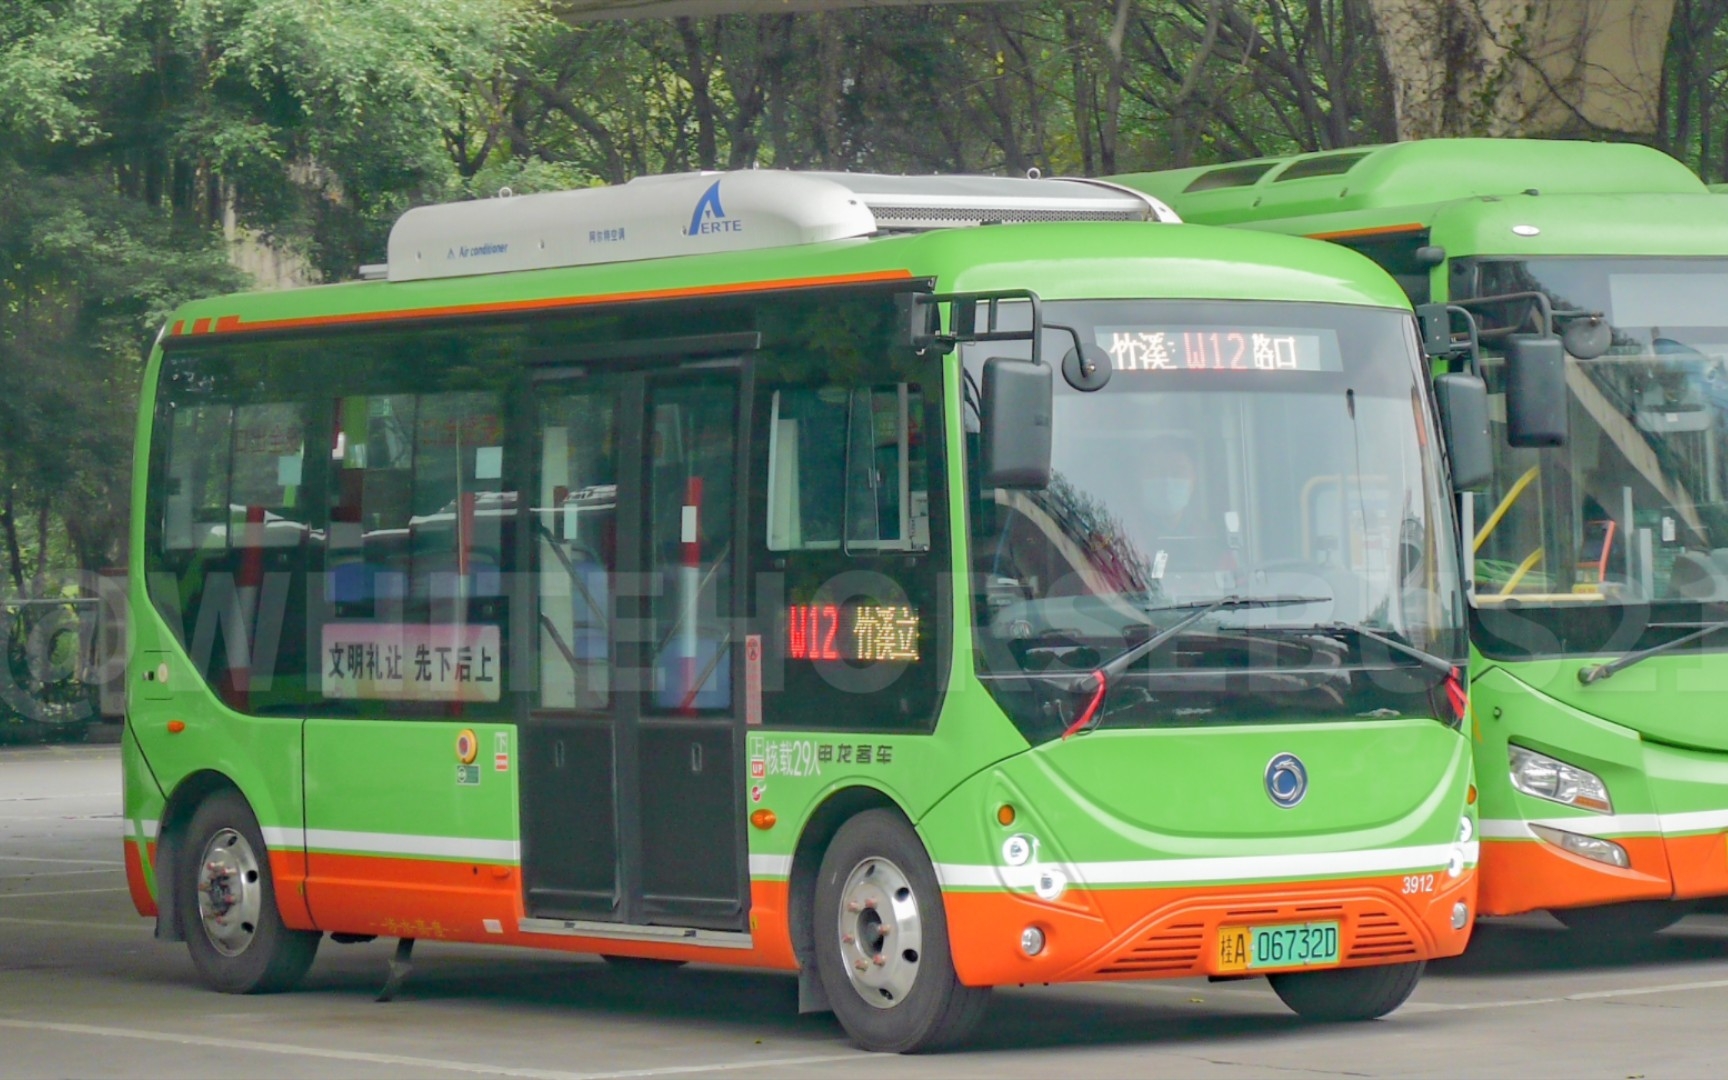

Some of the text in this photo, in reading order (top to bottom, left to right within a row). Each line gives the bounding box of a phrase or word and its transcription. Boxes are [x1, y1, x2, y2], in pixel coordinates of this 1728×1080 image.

[1183, 331, 1248, 371] W12
[789, 605, 840, 660] W12
[328, 641, 493, 683] 文明礼让 先下后上
[766, 740, 821, 777] 核载29人
[818, 743, 893, 764] 申龙客车
[1402, 874, 1434, 894] 3912
[1257, 927, 1337, 962] 06732D
